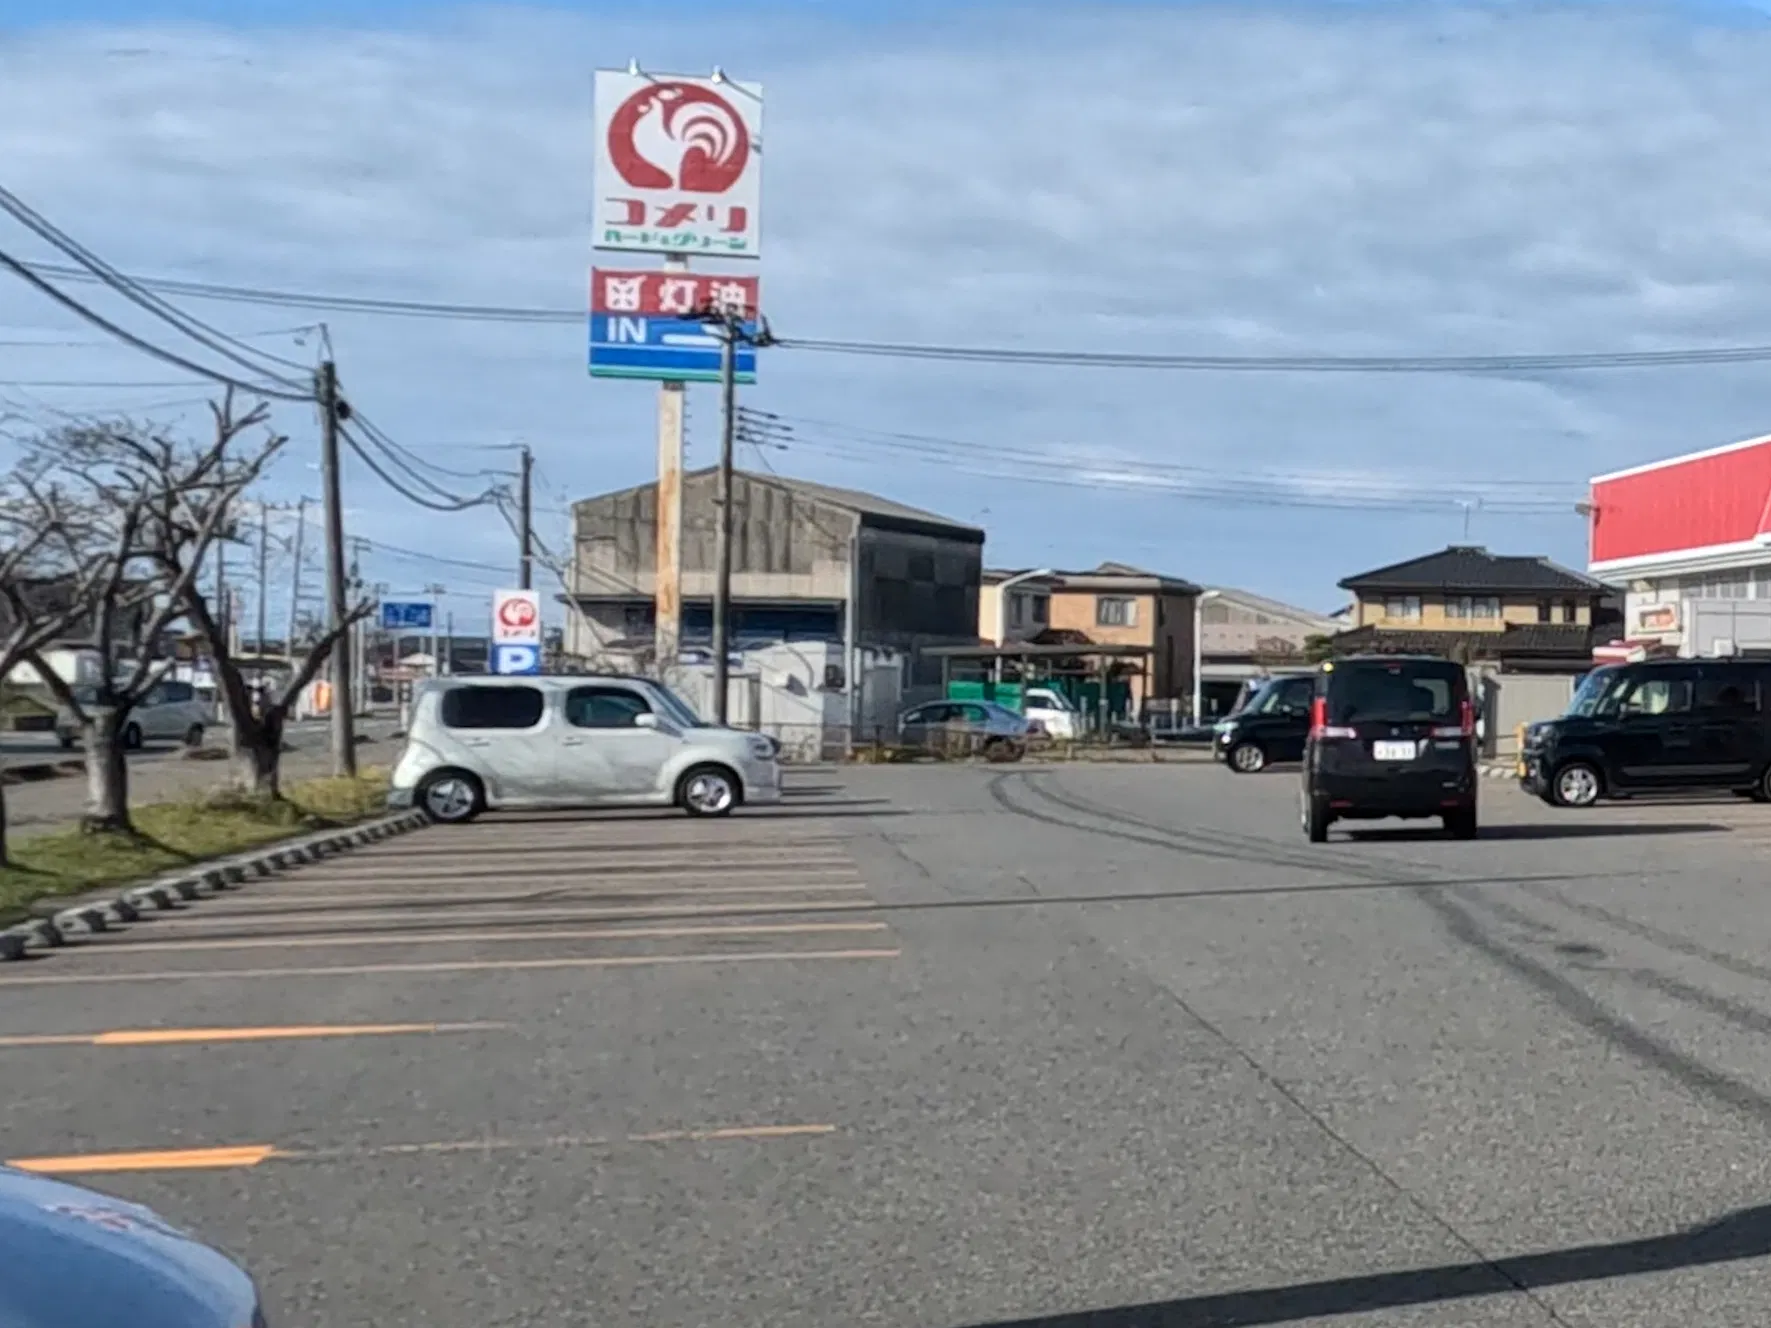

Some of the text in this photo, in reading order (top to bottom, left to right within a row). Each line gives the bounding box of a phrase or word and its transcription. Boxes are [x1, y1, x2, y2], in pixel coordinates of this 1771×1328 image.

[605, 197, 747, 233] コメリ
[607, 315, 647, 343] IN
[499, 646, 536, 673] P
